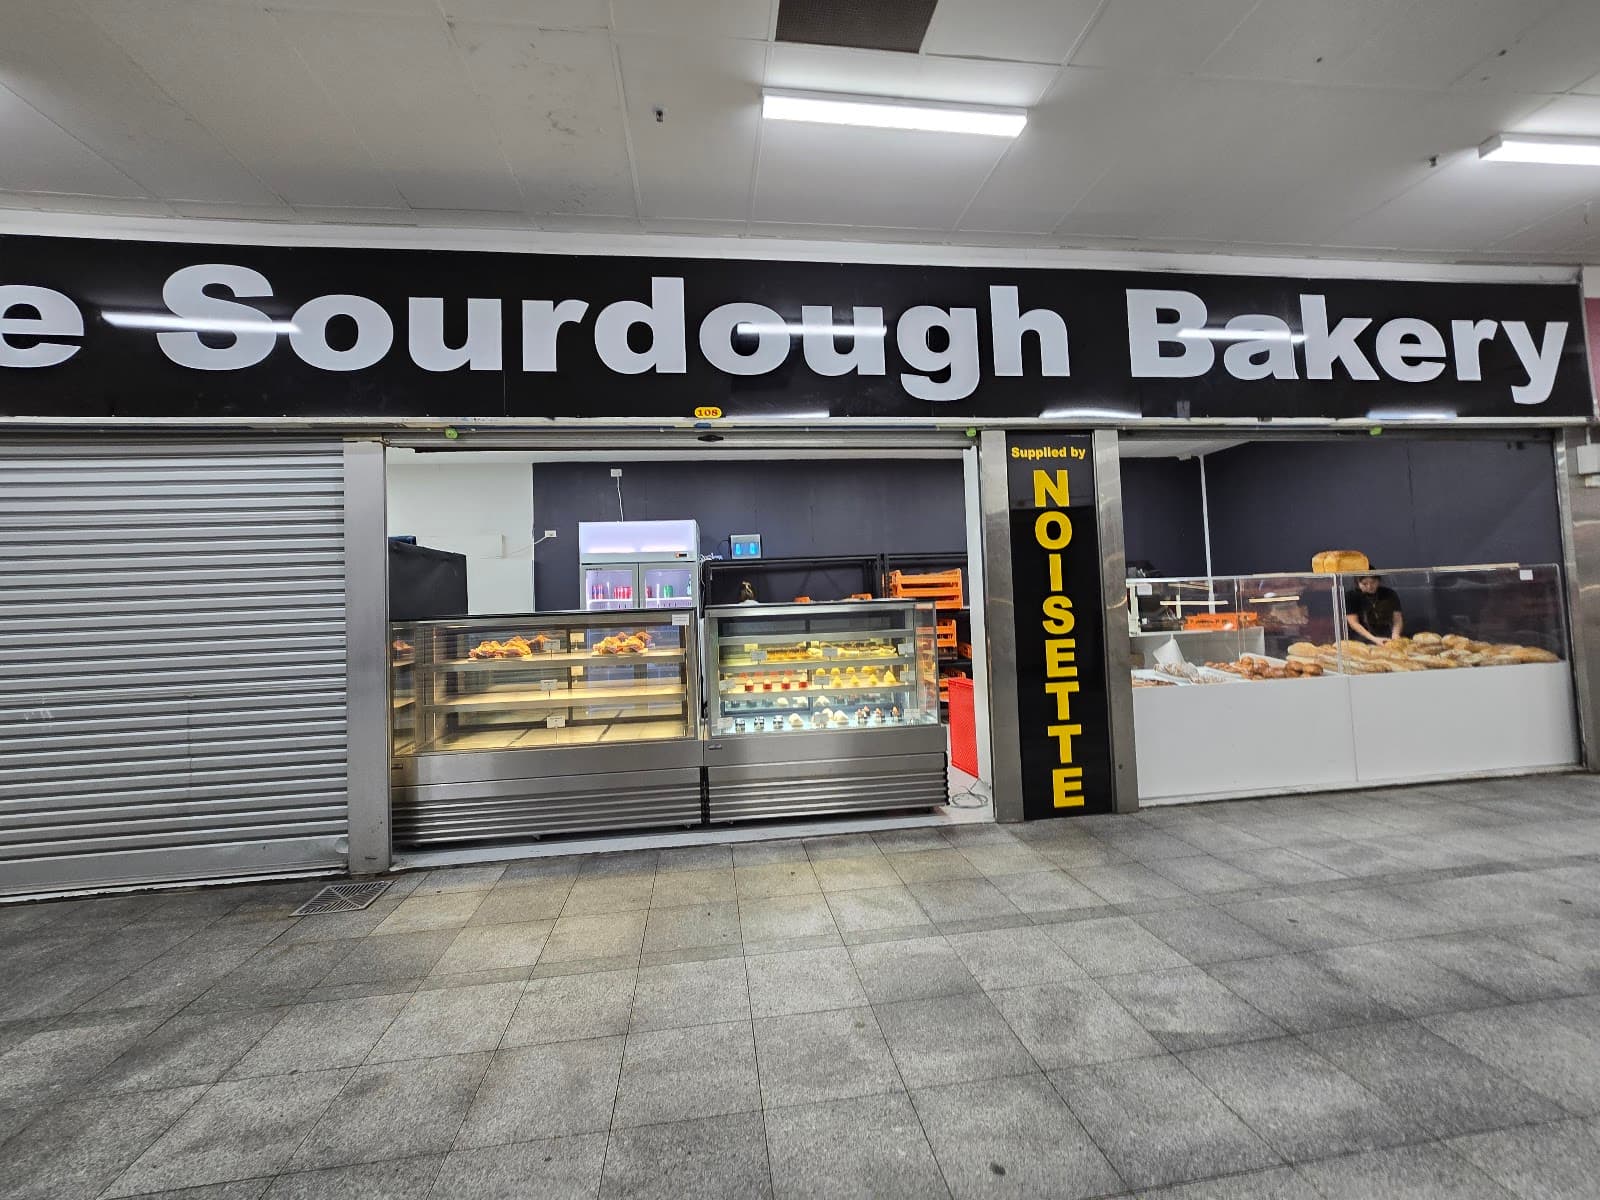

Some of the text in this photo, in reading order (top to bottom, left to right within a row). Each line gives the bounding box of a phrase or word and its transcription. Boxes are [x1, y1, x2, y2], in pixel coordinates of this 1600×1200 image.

[155, 263, 1071, 402] Sourdough
[1125, 288, 1569, 405] Bakery
[696, 408, 719, 417] 108
[1011, 446, 1086, 460] Supplied by
[1033, 469, 1085, 809] NOISETTE
